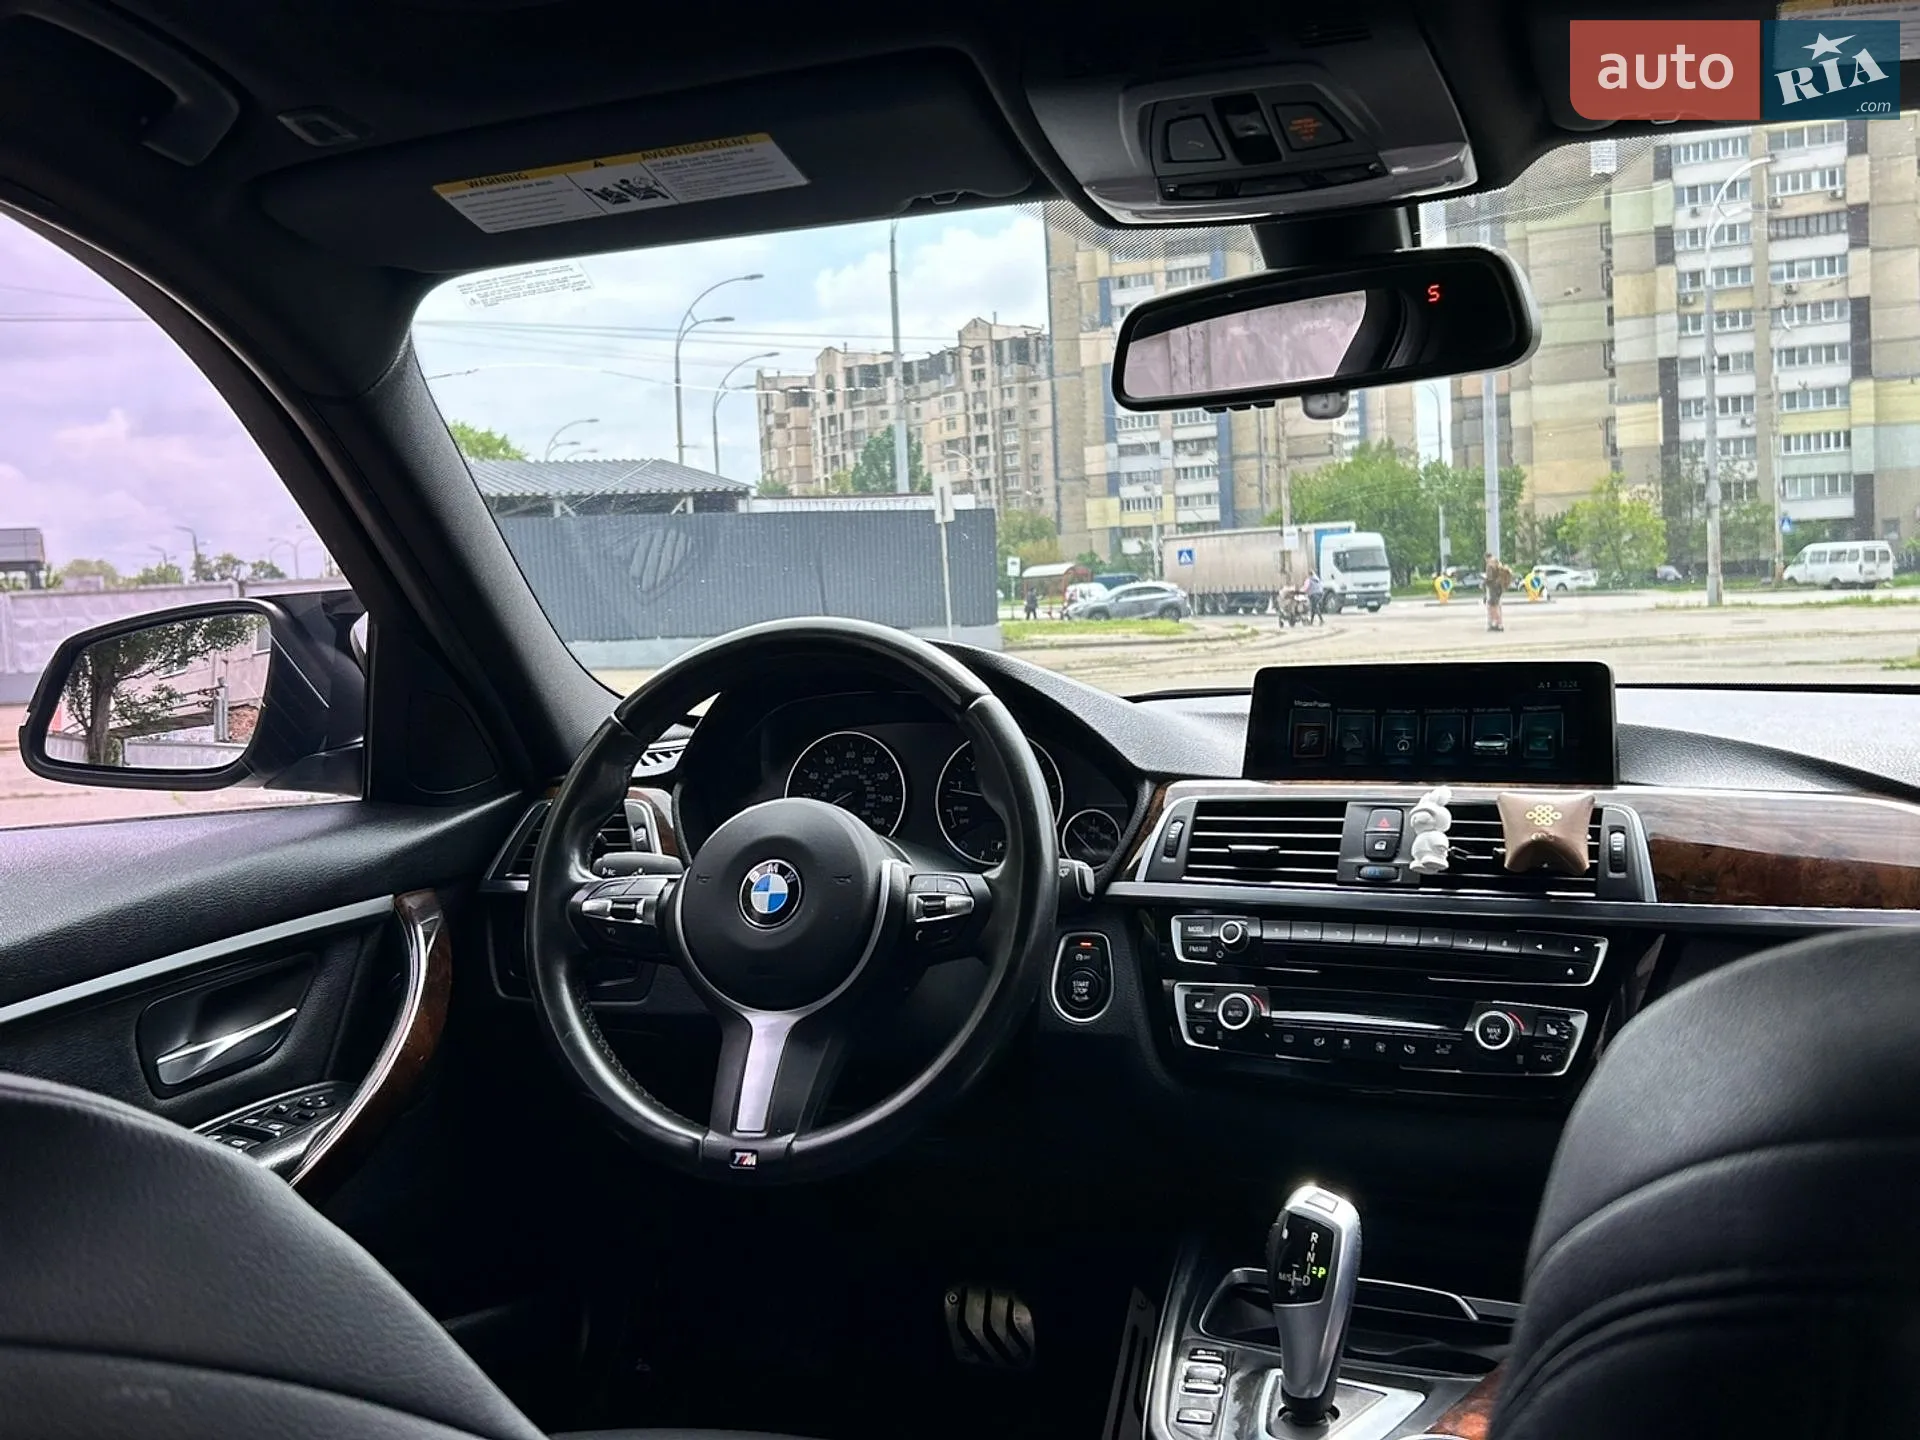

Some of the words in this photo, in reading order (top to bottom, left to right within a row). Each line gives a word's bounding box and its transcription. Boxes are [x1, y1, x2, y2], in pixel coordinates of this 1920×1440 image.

[640, 136, 751, 161] AVERTISSEMENT
[464, 172, 530, 189] WARNING
[1427, 284, 1440, 303] S
[749, 862, 798, 884] BMW
[1227, 1010, 1244, 1018] AUTO
[1310, 1232, 1319, 1243] R
[1306, 1251, 1316, 1263] N
[1317, 1266, 1326, 1278] P
[1302, 1274, 1310, 1286] D
